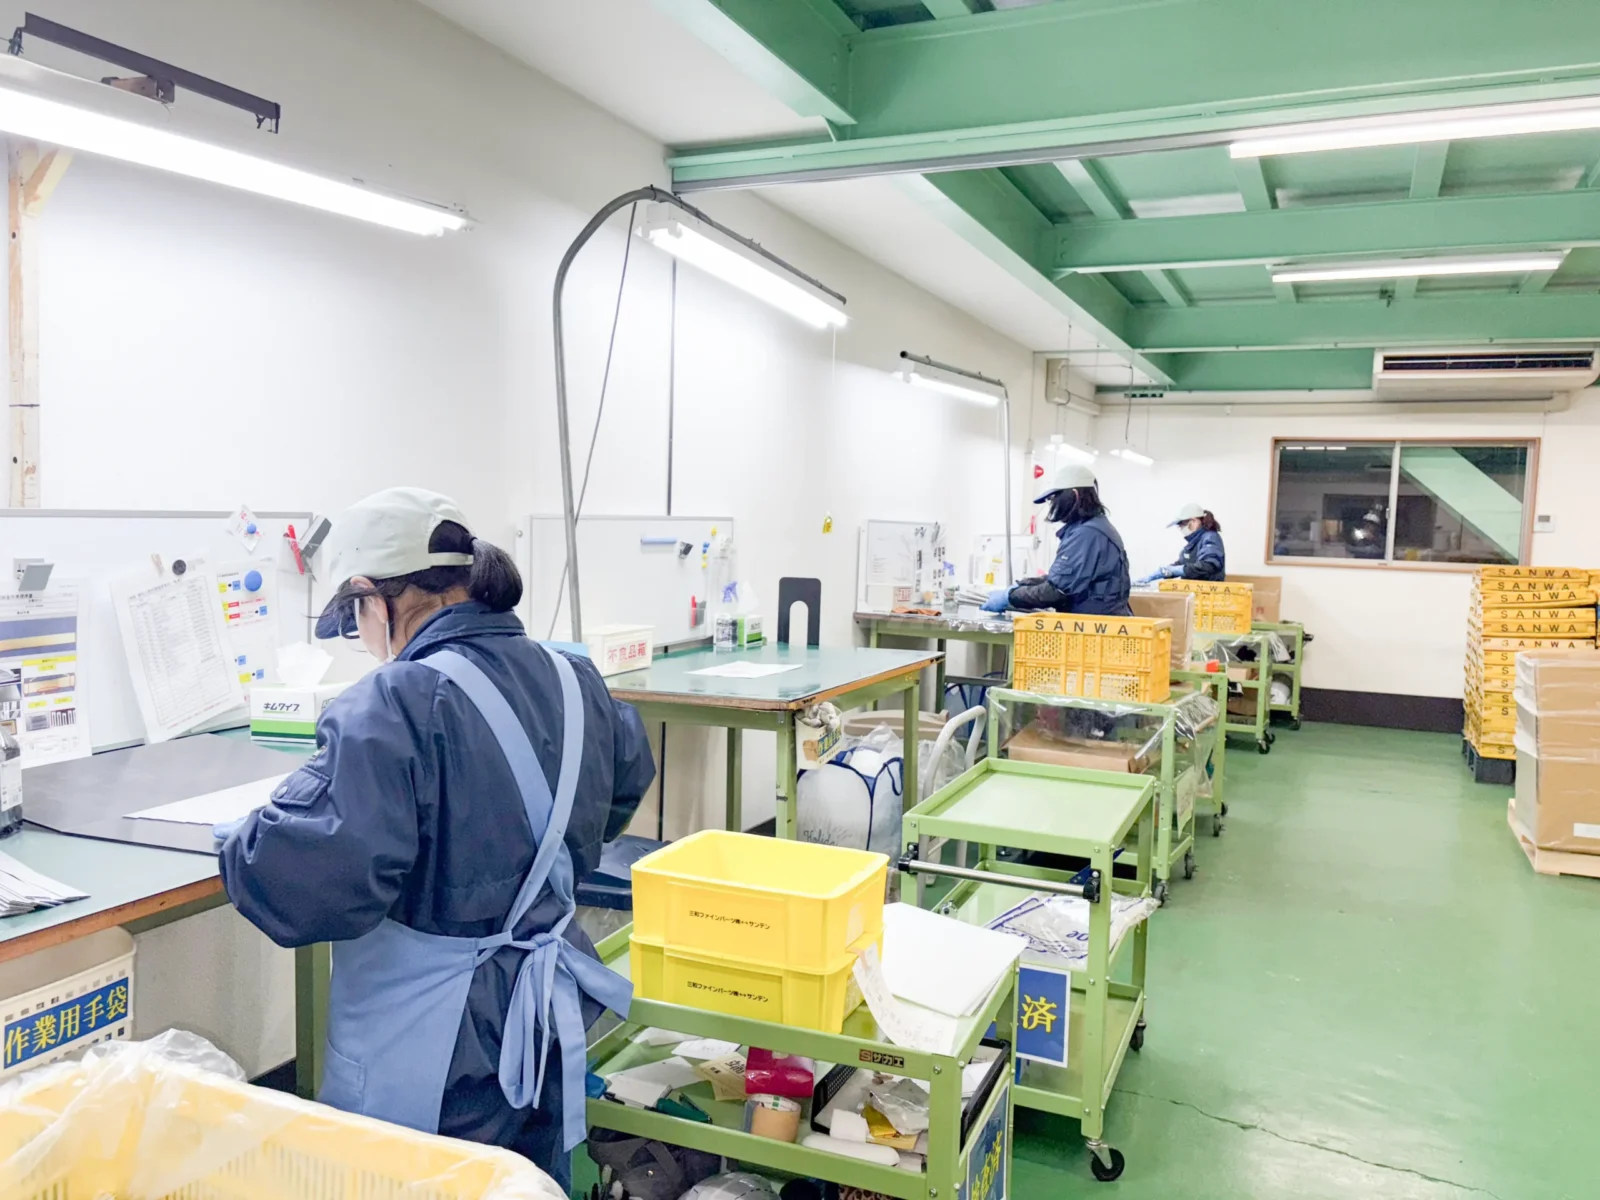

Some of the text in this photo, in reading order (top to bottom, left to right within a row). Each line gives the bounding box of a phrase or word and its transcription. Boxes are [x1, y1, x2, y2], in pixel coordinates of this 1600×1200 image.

[1498, 568, 1571, 578] SANWA
[1497, 581, 1570, 590] SANWA
[1500, 591, 1576, 603] SANWA
[1500, 610, 1576, 619] SANWA
[1034, 619, 1128, 635] SANWA
[1500, 624, 1577, 633] SANWA
[608, 643, 647, 662] 不良品箱
[4, 985, 127, 1065] 作業用手袋
